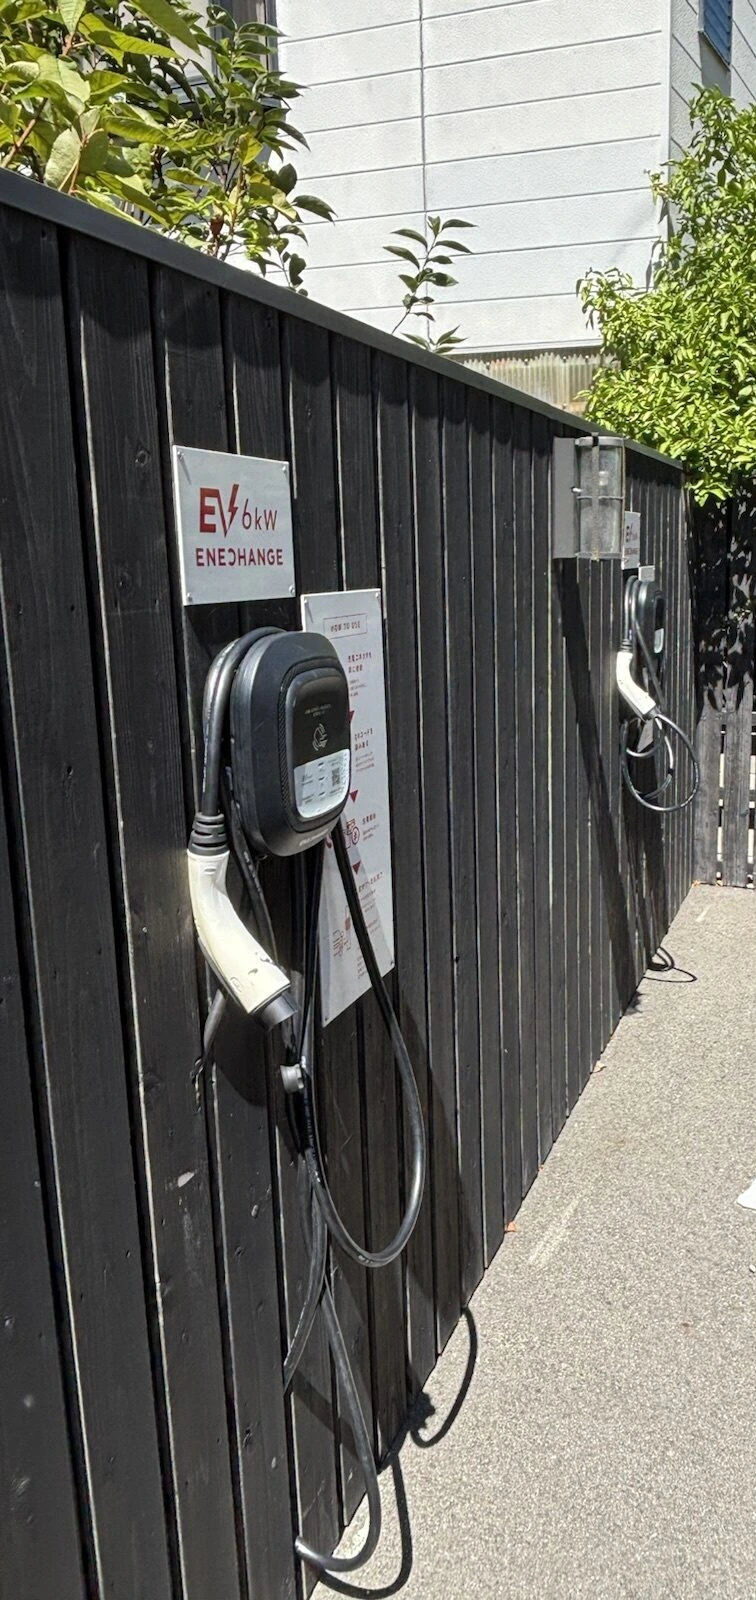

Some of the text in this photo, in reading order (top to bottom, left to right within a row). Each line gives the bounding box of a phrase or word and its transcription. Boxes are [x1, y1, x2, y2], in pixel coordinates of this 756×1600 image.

[200, 484, 278, 538] EV 6kW
[196, 548, 283, 567] ENECHANGE
